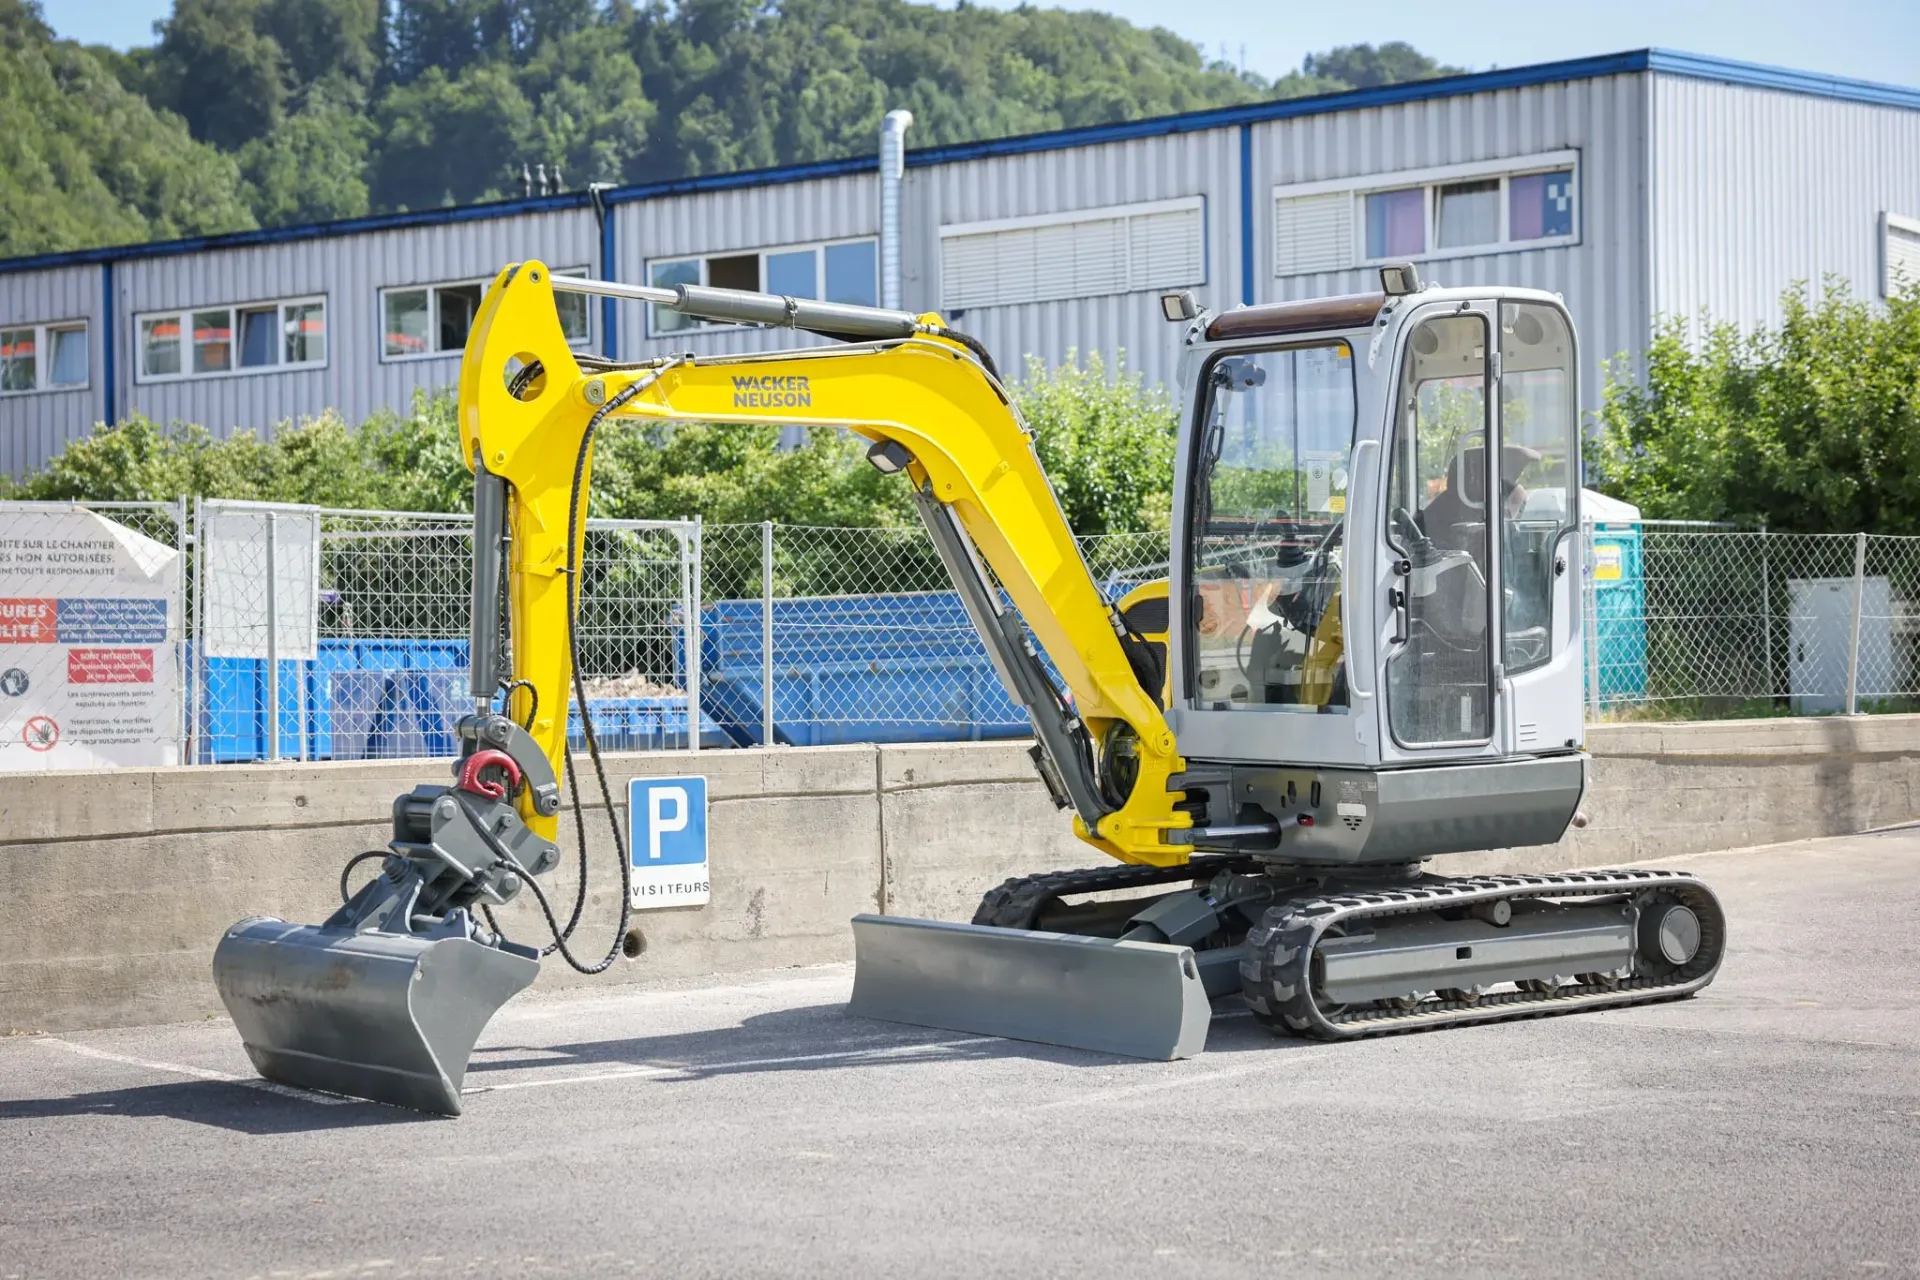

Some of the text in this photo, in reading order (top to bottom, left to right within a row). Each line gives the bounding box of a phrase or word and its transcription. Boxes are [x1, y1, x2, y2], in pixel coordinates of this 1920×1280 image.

[731, 375, 810, 391] WACKER
[733, 392, 811, 408] NEUSON
[22, 540, 43, 549] SUR
[46, 540, 58, 549] LE
[60, 540, 115, 550] CHANTIER
[15, 553, 42, 562] NON
[0, 604, 47, 618] URES
[648, 786, 688, 859] P
[632, 882, 710, 897] VISITEURS
